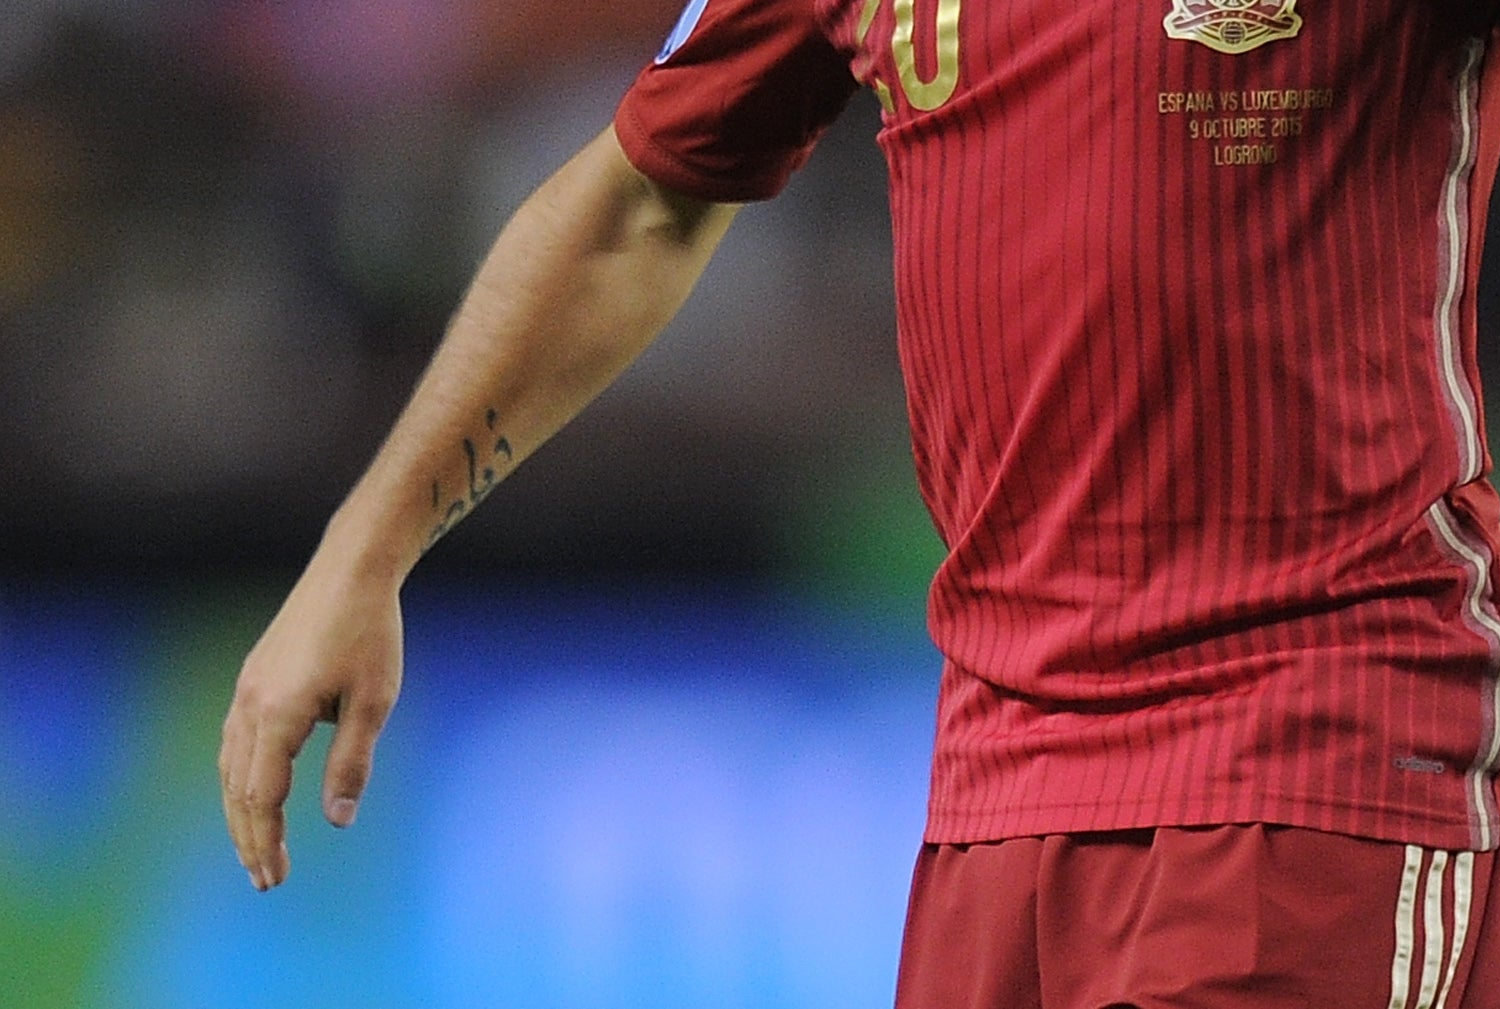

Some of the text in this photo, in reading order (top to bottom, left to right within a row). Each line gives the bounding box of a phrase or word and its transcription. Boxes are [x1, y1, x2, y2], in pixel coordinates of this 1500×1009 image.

[1219, 90, 1239, 112] VS
[1188, 116, 1304, 140] 9 OCTUBRE 2015
